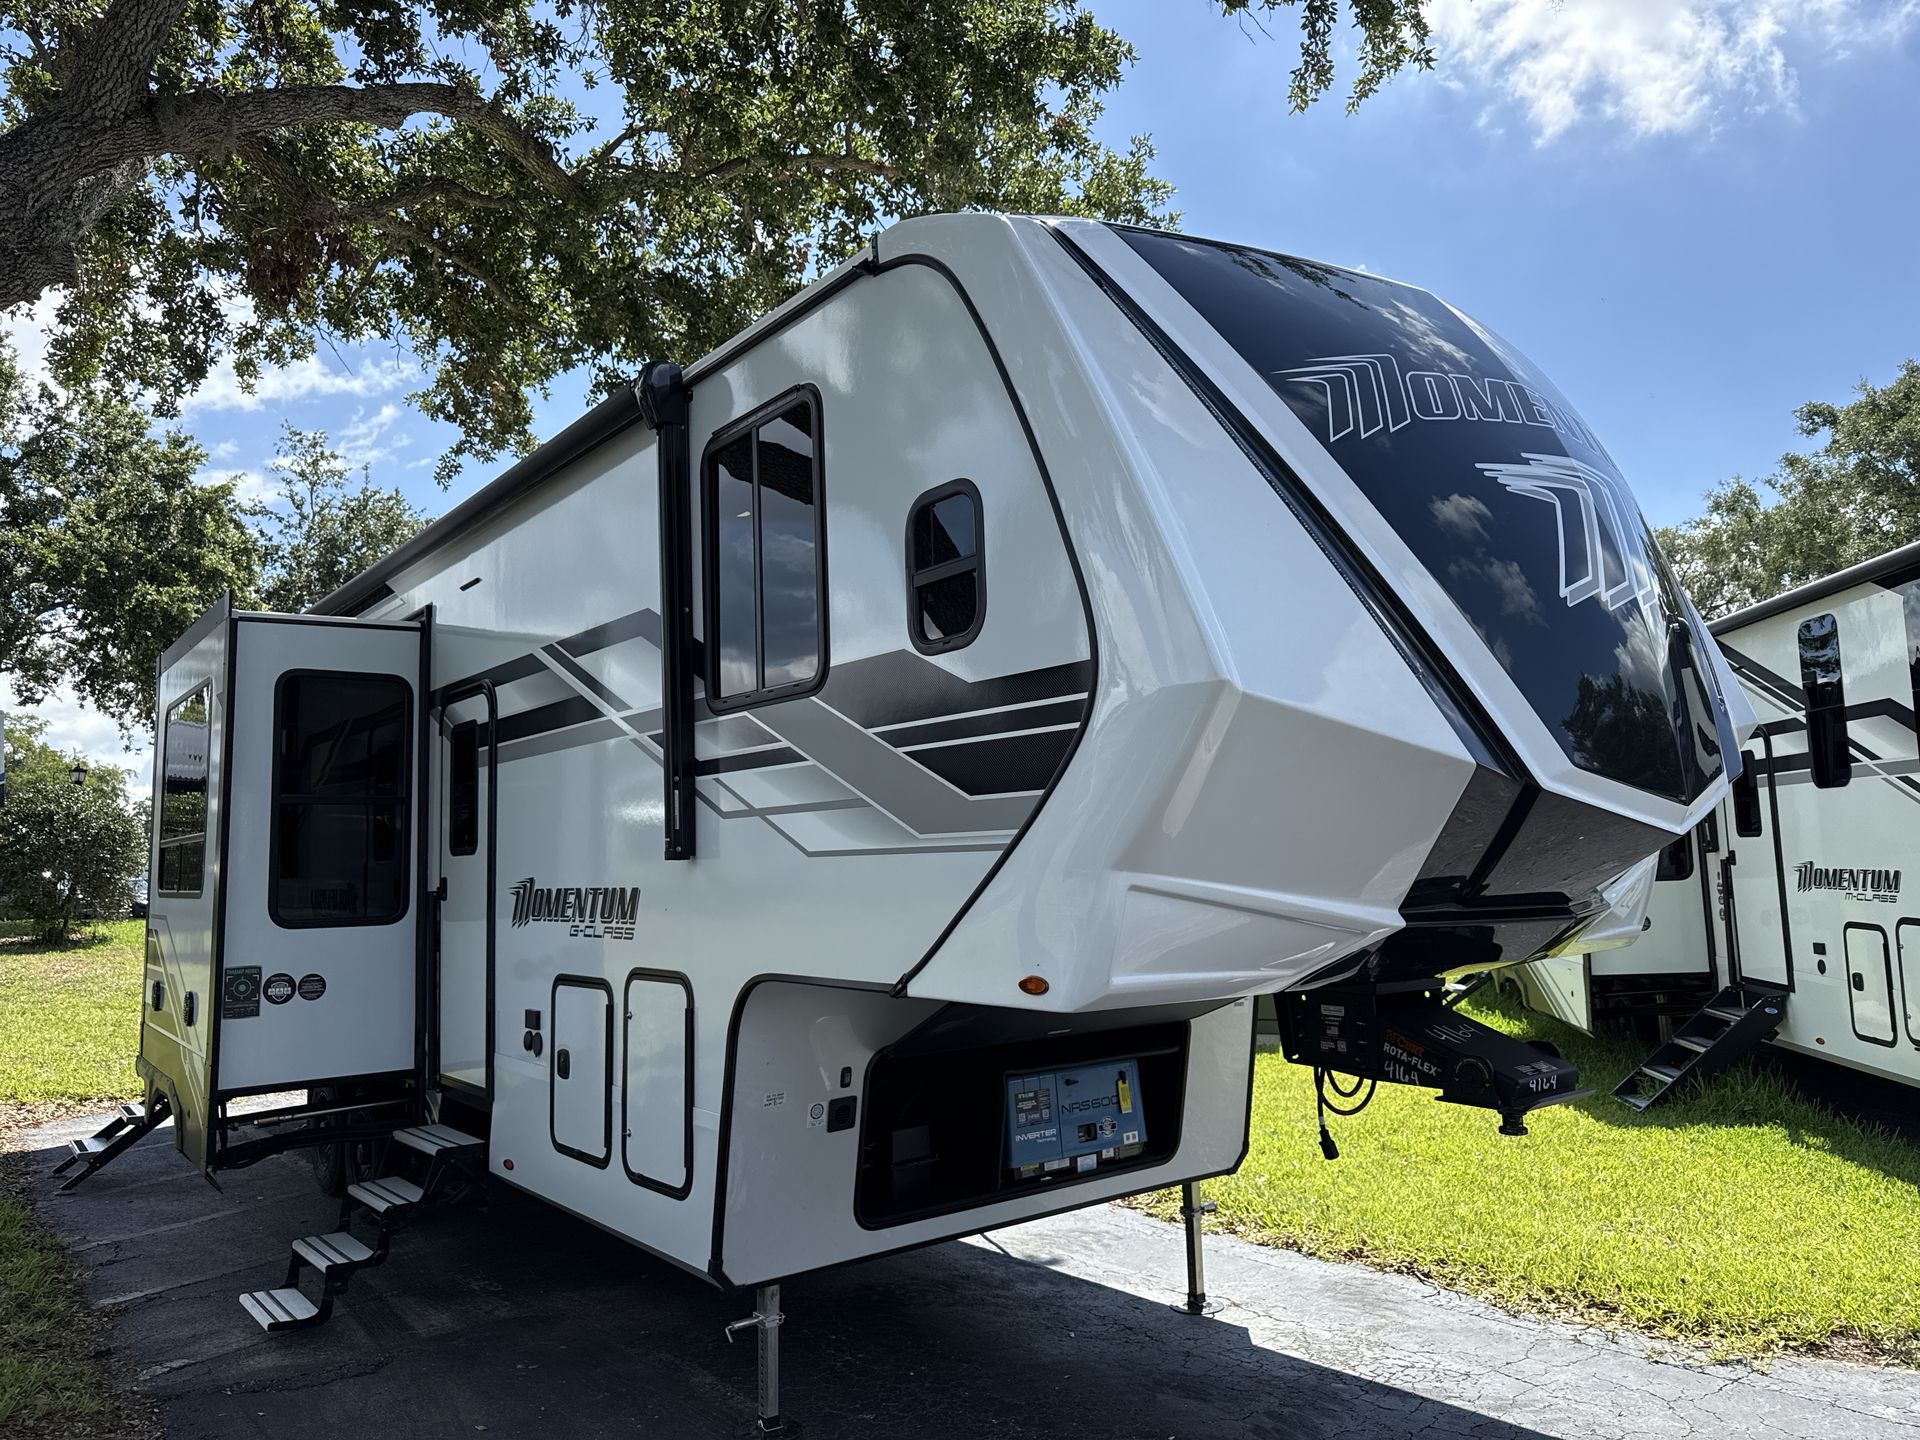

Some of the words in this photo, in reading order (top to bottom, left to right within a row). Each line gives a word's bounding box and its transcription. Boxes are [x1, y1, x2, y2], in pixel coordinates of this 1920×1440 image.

[1792, 860, 1902, 893] MOMENTUM
[507, 876, 641, 928] MOMENTUM
[1844, 892, 1898, 904] M-CLASS
[569, 925, 635, 940] G-CLASS
[1529, 1074, 1557, 1092] 4164
[1061, 1095, 1119, 1114] NPS600
[1015, 1128, 1057, 1142] INVERTER
